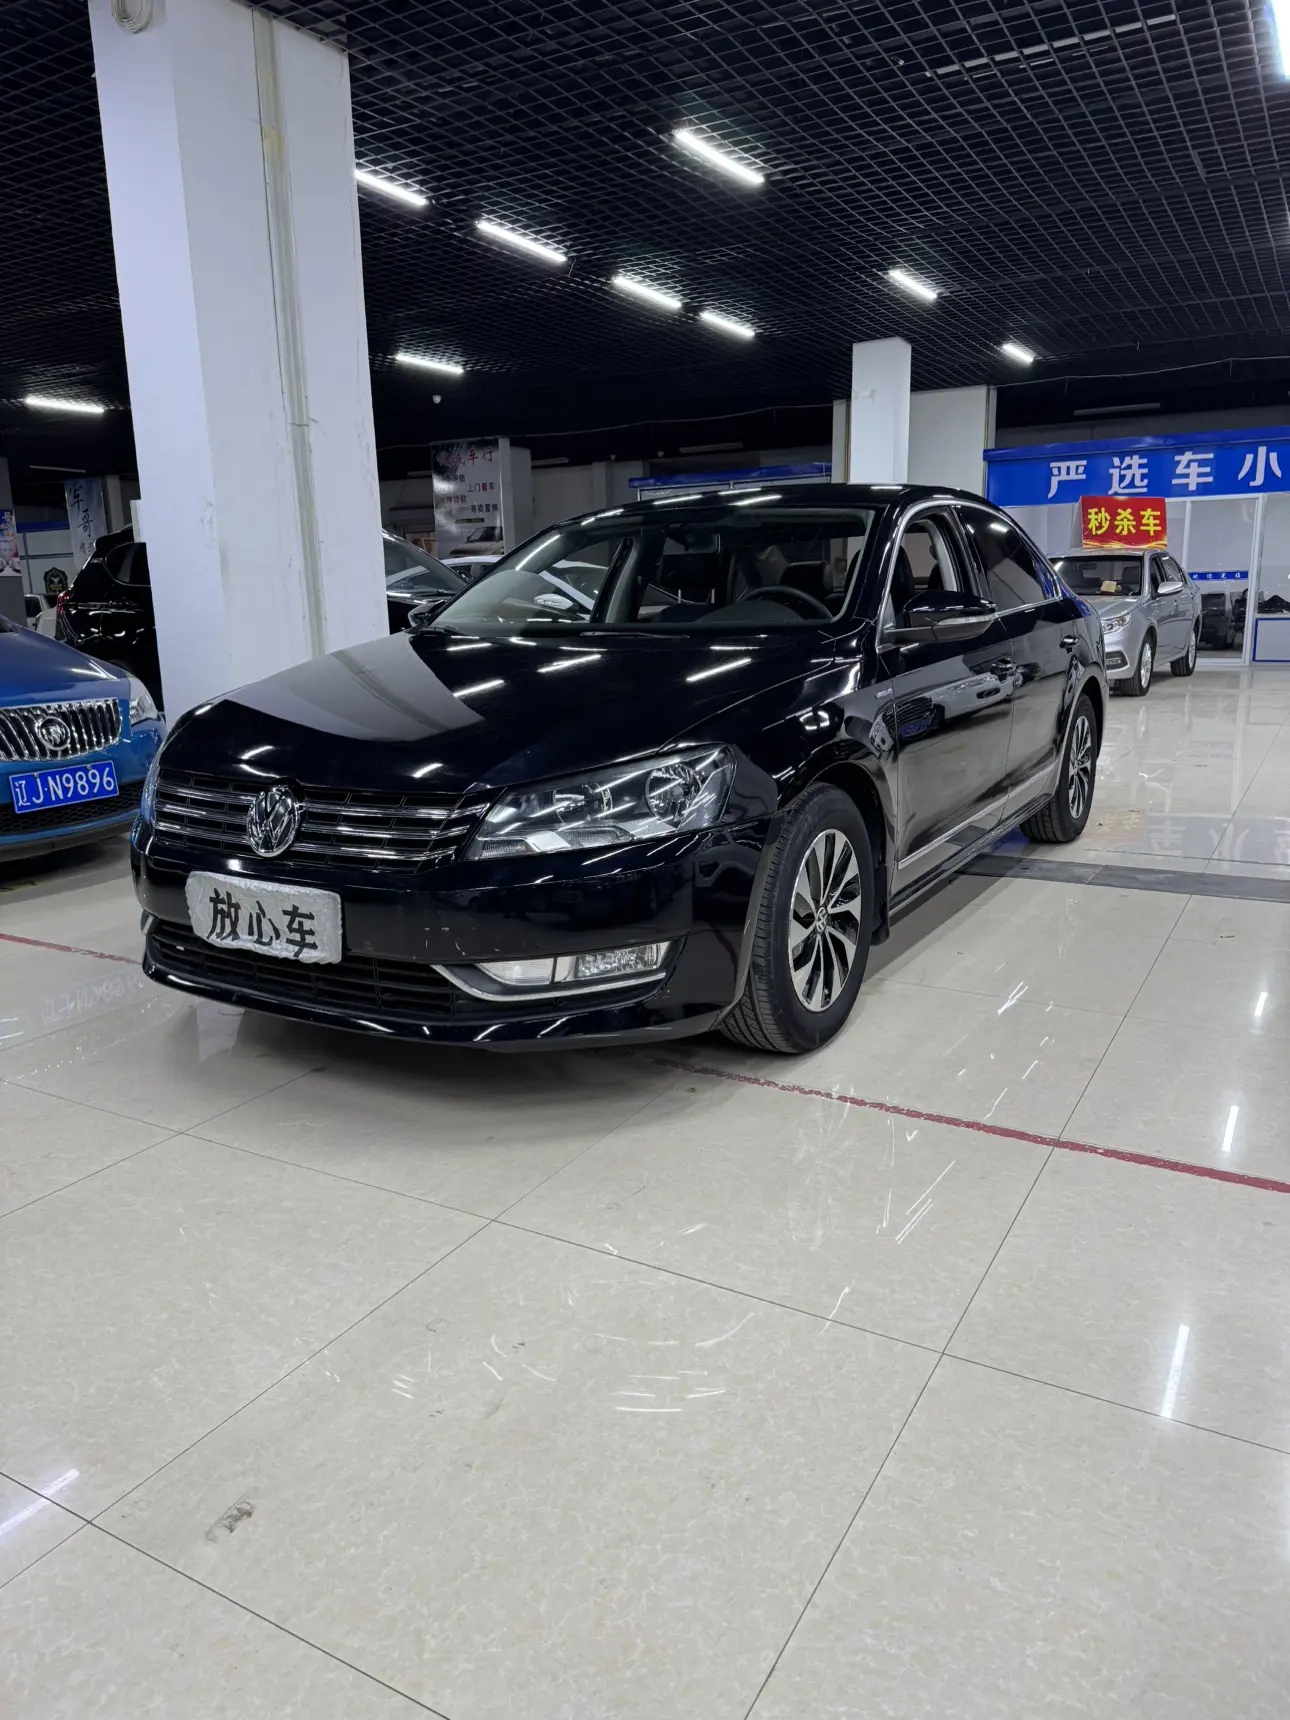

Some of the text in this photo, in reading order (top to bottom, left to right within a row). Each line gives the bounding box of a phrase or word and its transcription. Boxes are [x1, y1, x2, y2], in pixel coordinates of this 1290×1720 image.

[1047, 446, 1282, 499] 严选车小
[1087, 508, 1162, 536] 秒杀车
[207, 887, 319, 957] 放心车
